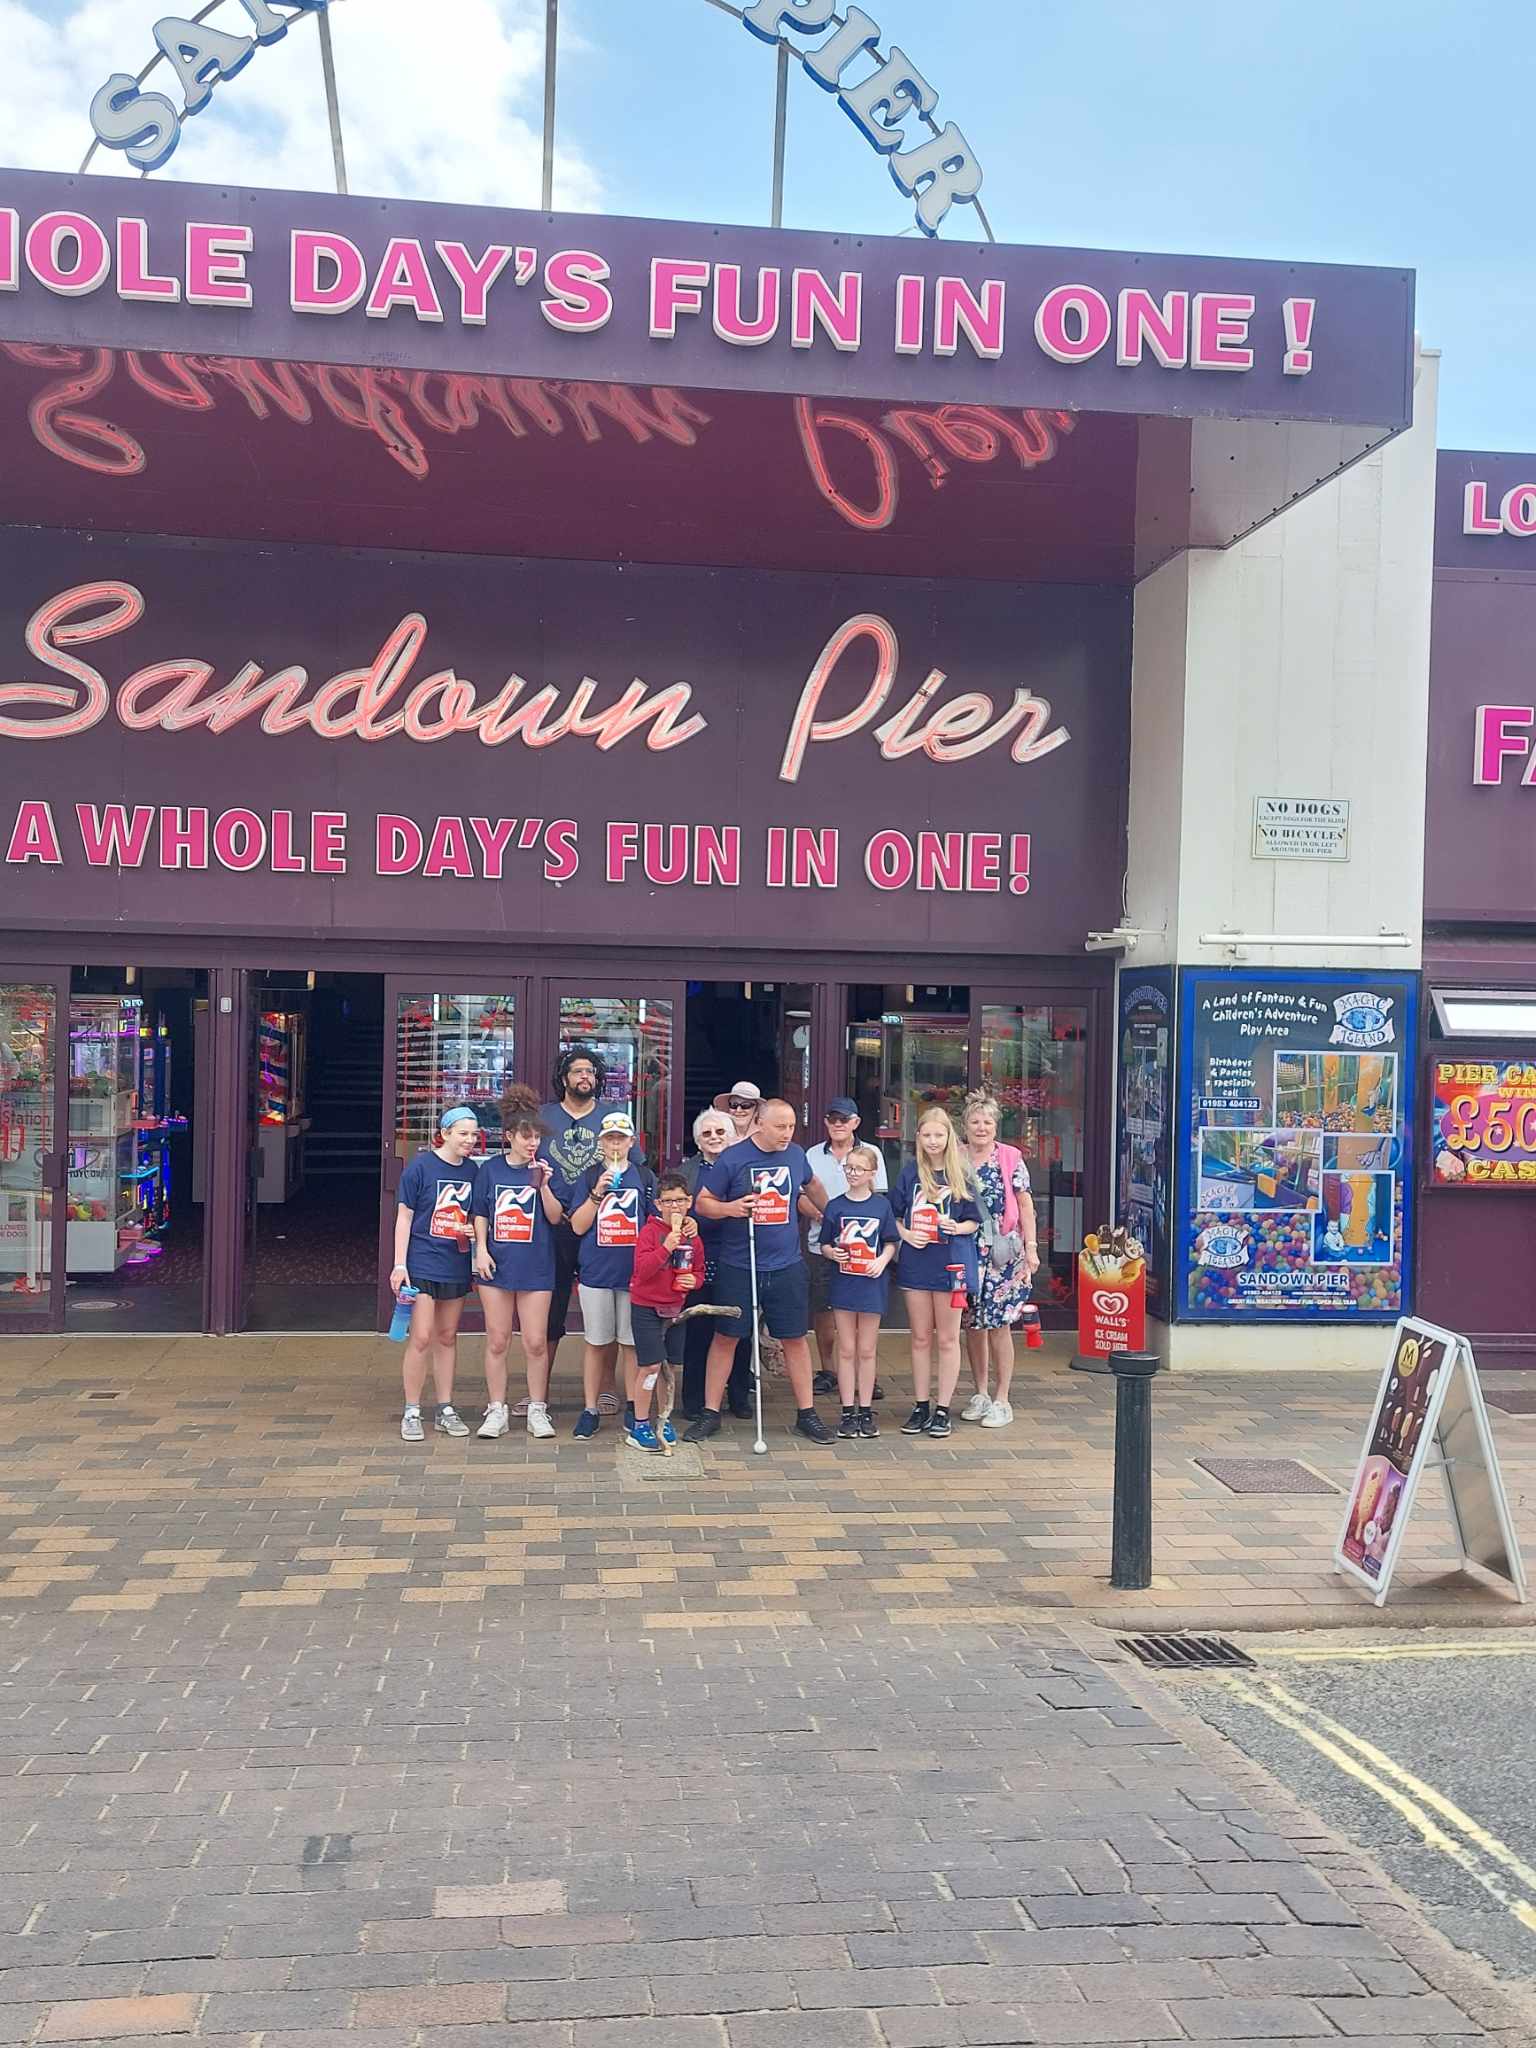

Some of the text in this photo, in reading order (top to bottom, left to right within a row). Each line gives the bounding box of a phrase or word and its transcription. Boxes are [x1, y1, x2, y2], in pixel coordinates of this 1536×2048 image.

[0, 207, 253, 310] OLE
[290, 229, 613, 332] DAY'S
[649, 258, 863, 353] FUN
[896, 274, 1005, 359] IN
[1033, 284, 1255, 372] ONE
[0, 580, 1071, 782] Sandown Pier
[1472, 705, 1536, 786] F
[1266, 802, 1341, 816] NO DOGS
[1261, 828, 1344, 841] NO BICYCLES
[5, 801, 1032, 894] A WHOLE DAY'S FUN IN ONE!
[1203, 991, 1328, 1013] A Land of Fantasy & Fun
[1340, 993, 1386, 1009] MAGIC
[1212, 1007, 1318, 1024] Children's Adventure
[1240, 1023, 1289, 1037] Play Area
[1341, 1030, 1386, 1047] ISLAND
[1210, 1057, 1253, 1068] Birthdays
[1210, 1068, 1252, 1077] & Parties
[1438, 1064, 1498, 1084] PIER
[1222, 1088, 1239, 1097] call
[497, 1215, 517, 1223] Blind
[600, 1220, 620, 1228] Blind
[755, 1214, 768, 1223] UK
[497, 1231, 509, 1239] UK
[600, 1228, 635, 1236] Veterans
[600, 1235, 612, 1243] UK
[1239, 1273, 1349, 1286] SANDOWN PIER
[1094, 1314, 1127, 1327] WALL'S
[1094, 1328, 1128, 1342] ICE CREAM
[1095, 1339, 1112, 1350] SOLD
[1402, 1345, 1415, 1365] M
